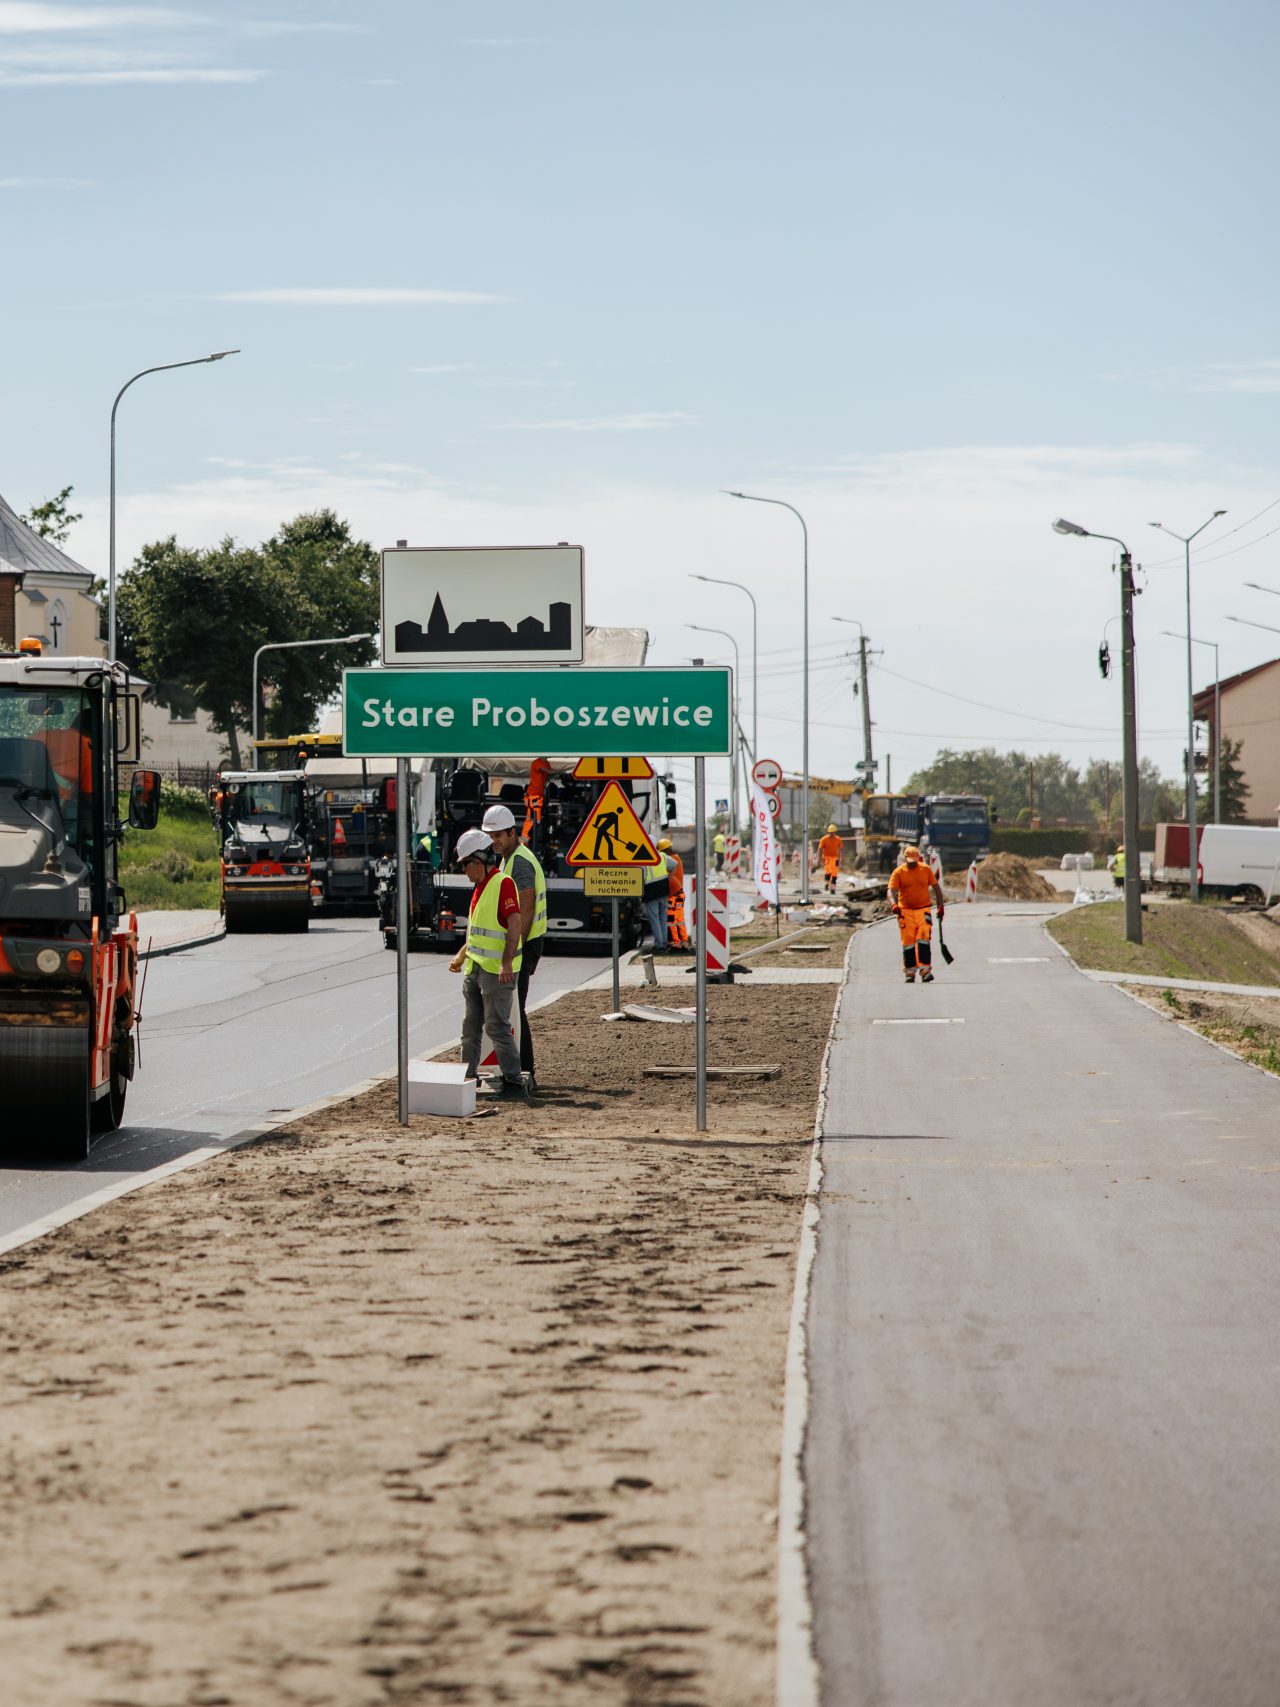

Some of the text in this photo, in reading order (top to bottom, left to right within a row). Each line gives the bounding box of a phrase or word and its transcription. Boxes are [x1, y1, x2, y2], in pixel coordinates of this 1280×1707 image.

[361, 697, 713, 727] Stare Proboszewice
[598, 869, 629, 877] Ręczne
